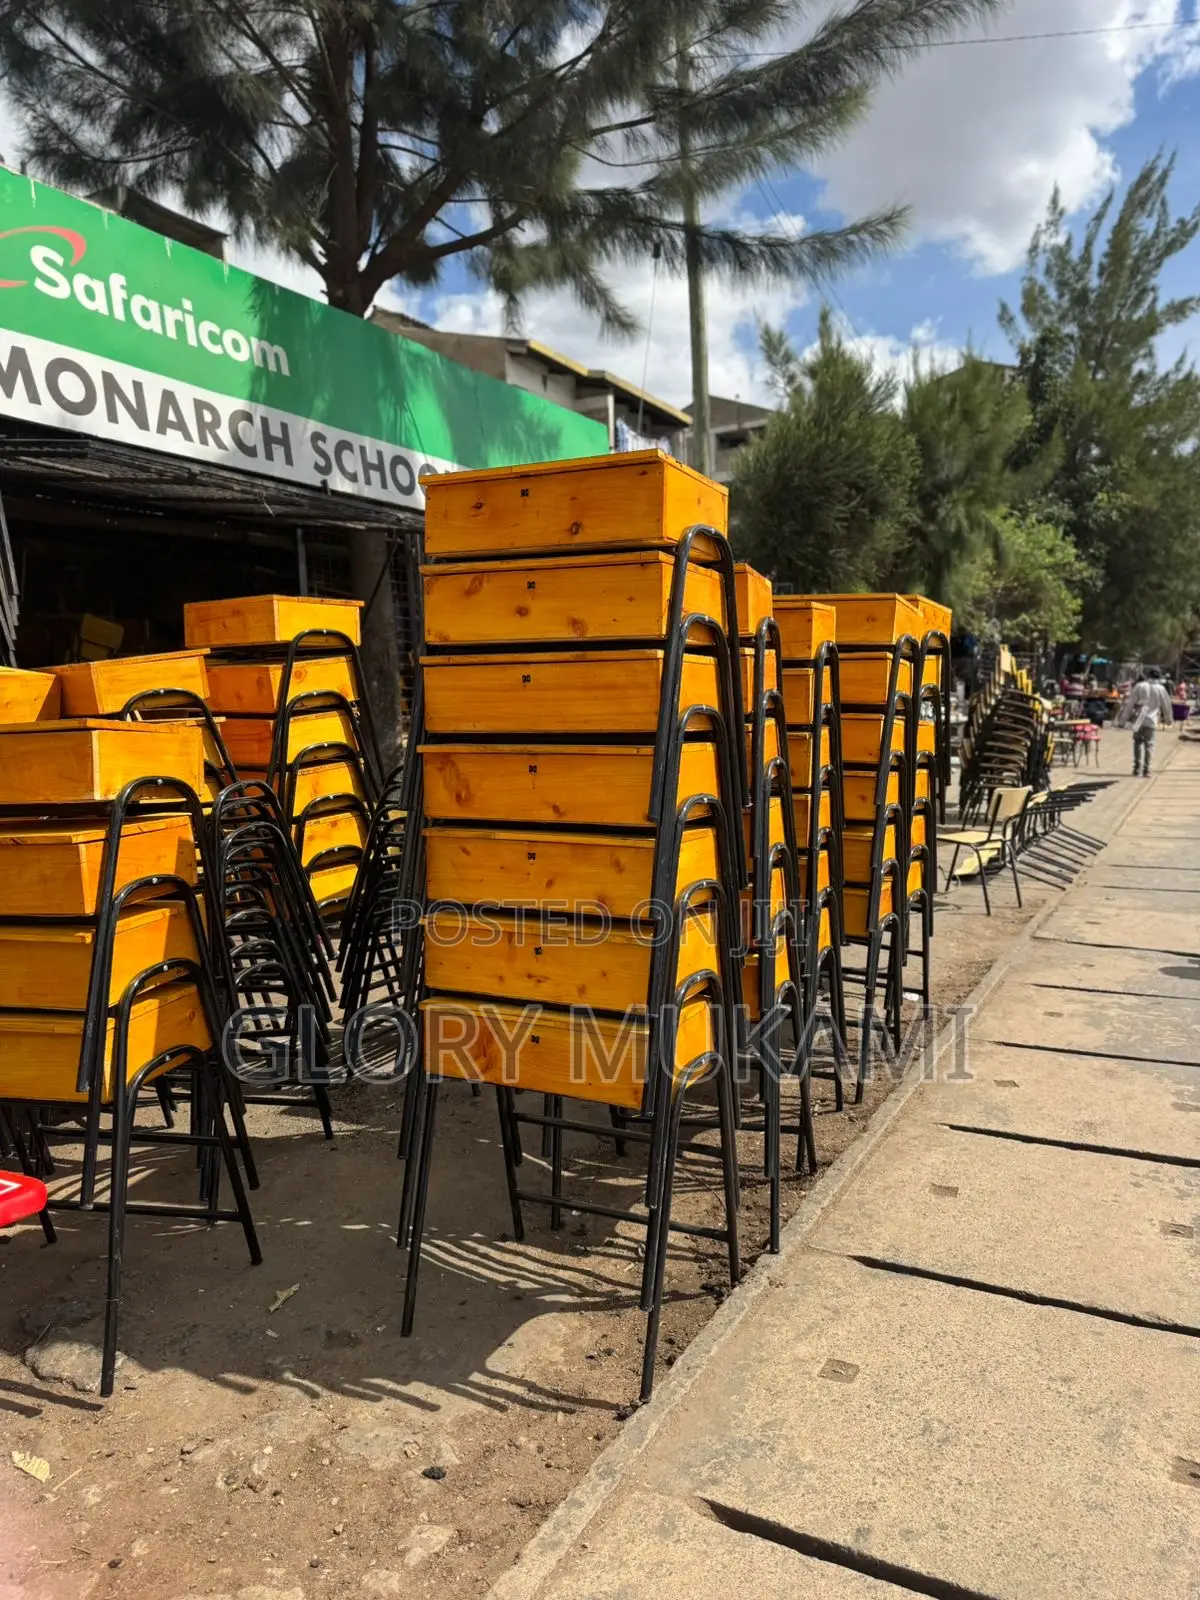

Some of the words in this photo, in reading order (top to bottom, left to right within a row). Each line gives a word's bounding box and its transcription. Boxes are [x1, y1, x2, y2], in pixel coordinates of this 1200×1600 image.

[30, 245, 291, 377] Safaricom
[0, 345, 294, 467] MONARCH
[310, 431, 449, 497] SCHO
